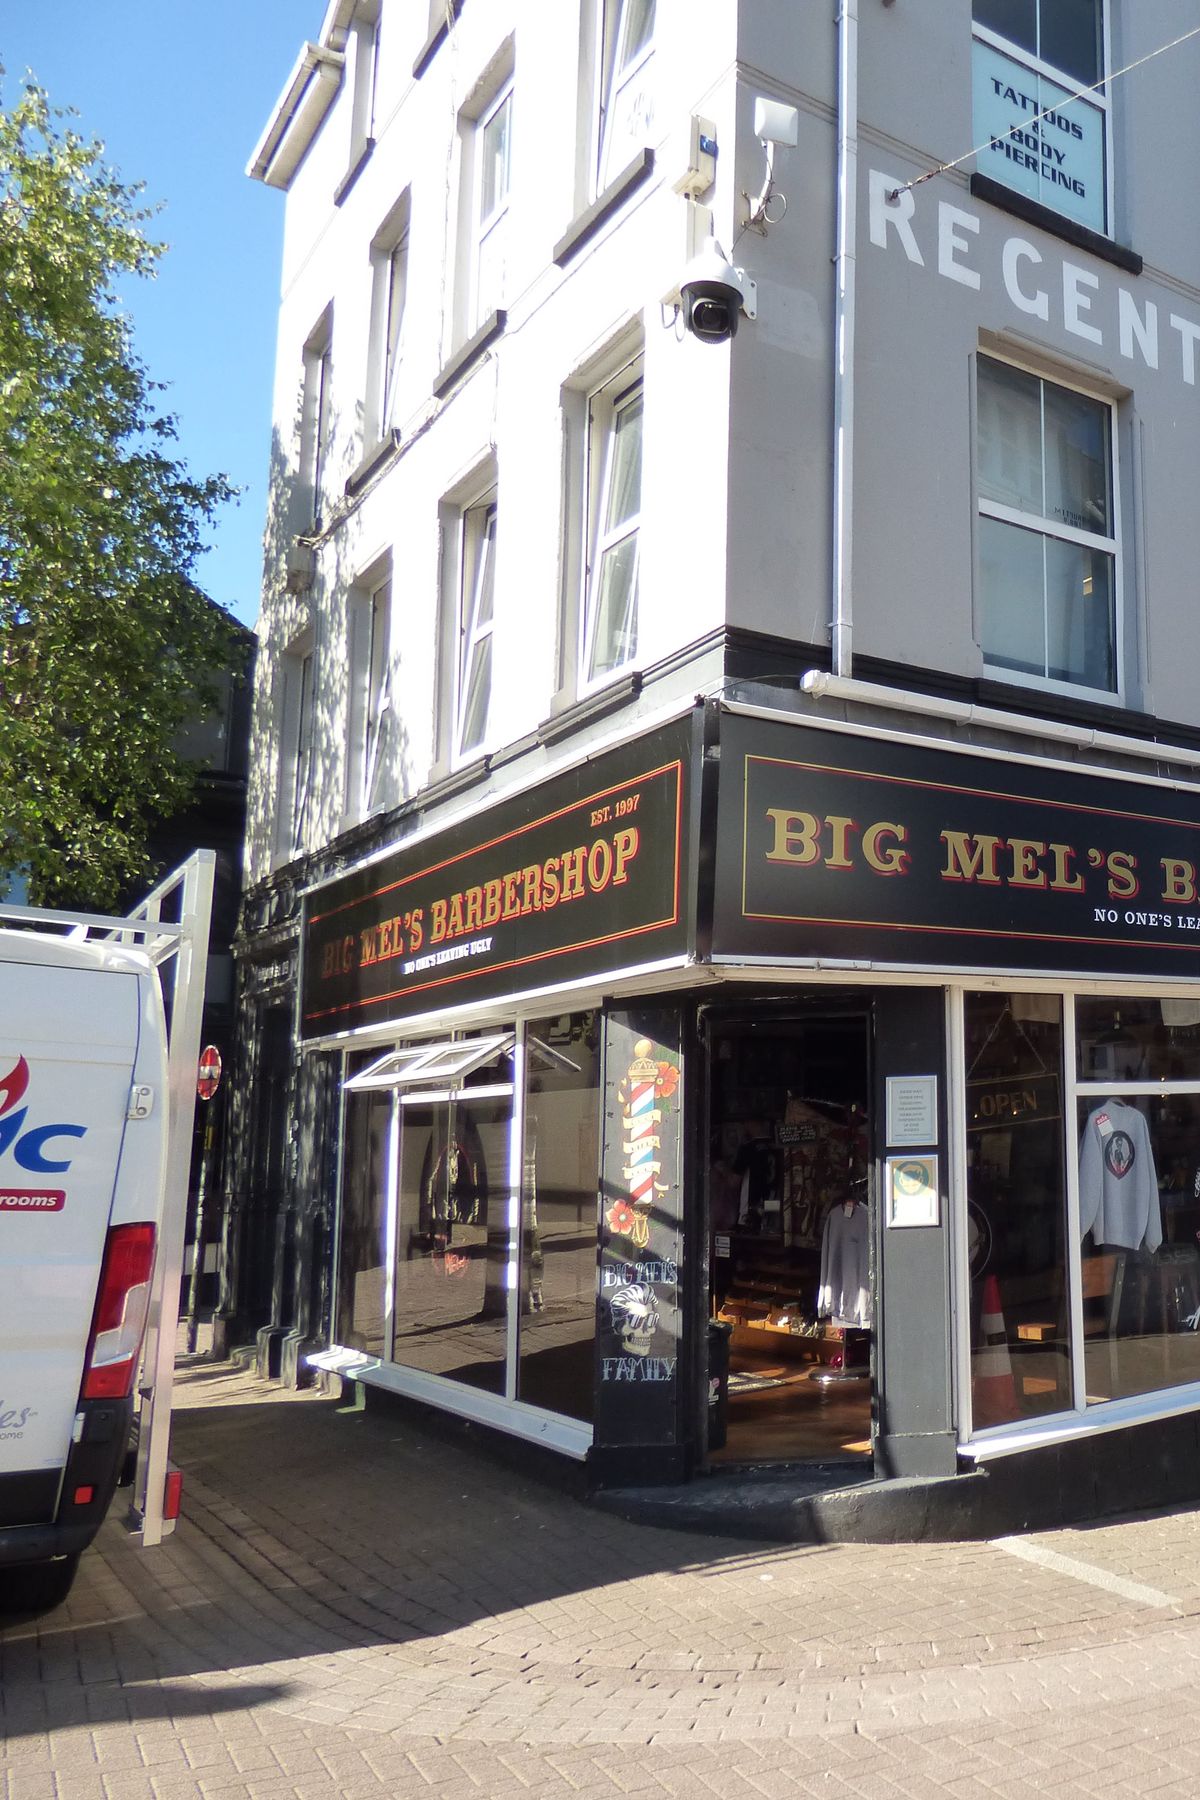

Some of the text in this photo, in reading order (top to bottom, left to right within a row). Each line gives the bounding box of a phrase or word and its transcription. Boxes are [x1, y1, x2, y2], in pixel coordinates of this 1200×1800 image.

[990, 76, 1083, 140] TATTOOS
[1010, 124, 1066, 166] BODY
[990, 135, 1085, 198] PIERCING
[591, 795, 640, 827] EST. 1997
[765, 808, 912, 876] BIG
[940, 830, 1139, 899] MEL'S
[322, 827, 640, 980] BIG MEL'S BARBERSHOP
[1094, 908, 1119, 924] NO
[1124, 911, 1172, 929] ONE'S
[470, 937, 494, 955] UGLY
[980, 1089, 1037, 1116] OPEN
[603, 1262, 634, 1288] BIG
[602, 1357, 678, 1381] FAMILY
